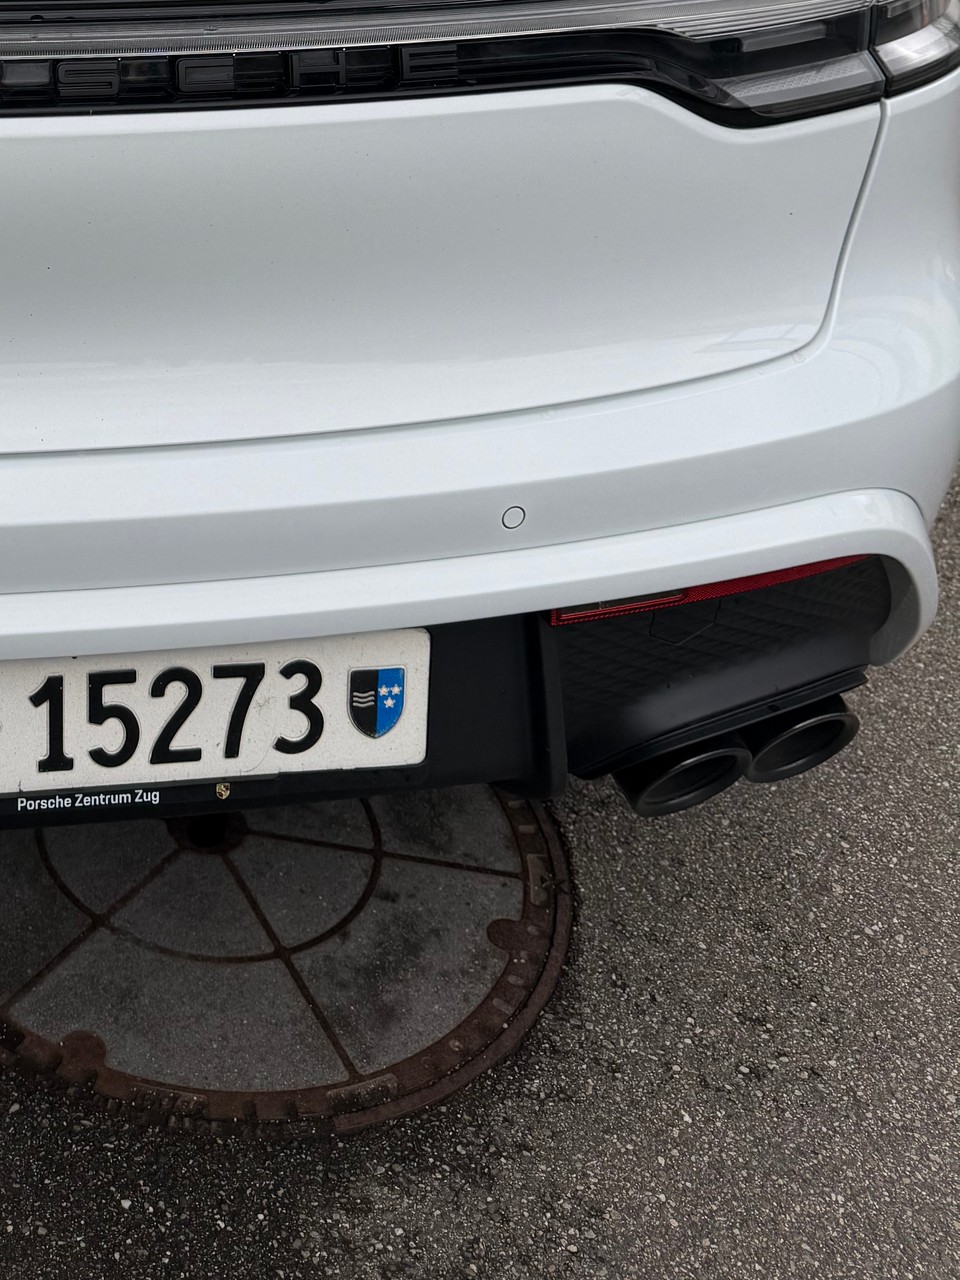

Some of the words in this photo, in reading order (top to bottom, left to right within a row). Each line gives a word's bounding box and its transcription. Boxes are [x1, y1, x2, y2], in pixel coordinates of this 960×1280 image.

[17, 795, 72, 811] Porsche
[74, 792, 132, 807] Zentrum
[134, 789, 160, 805] Zug
